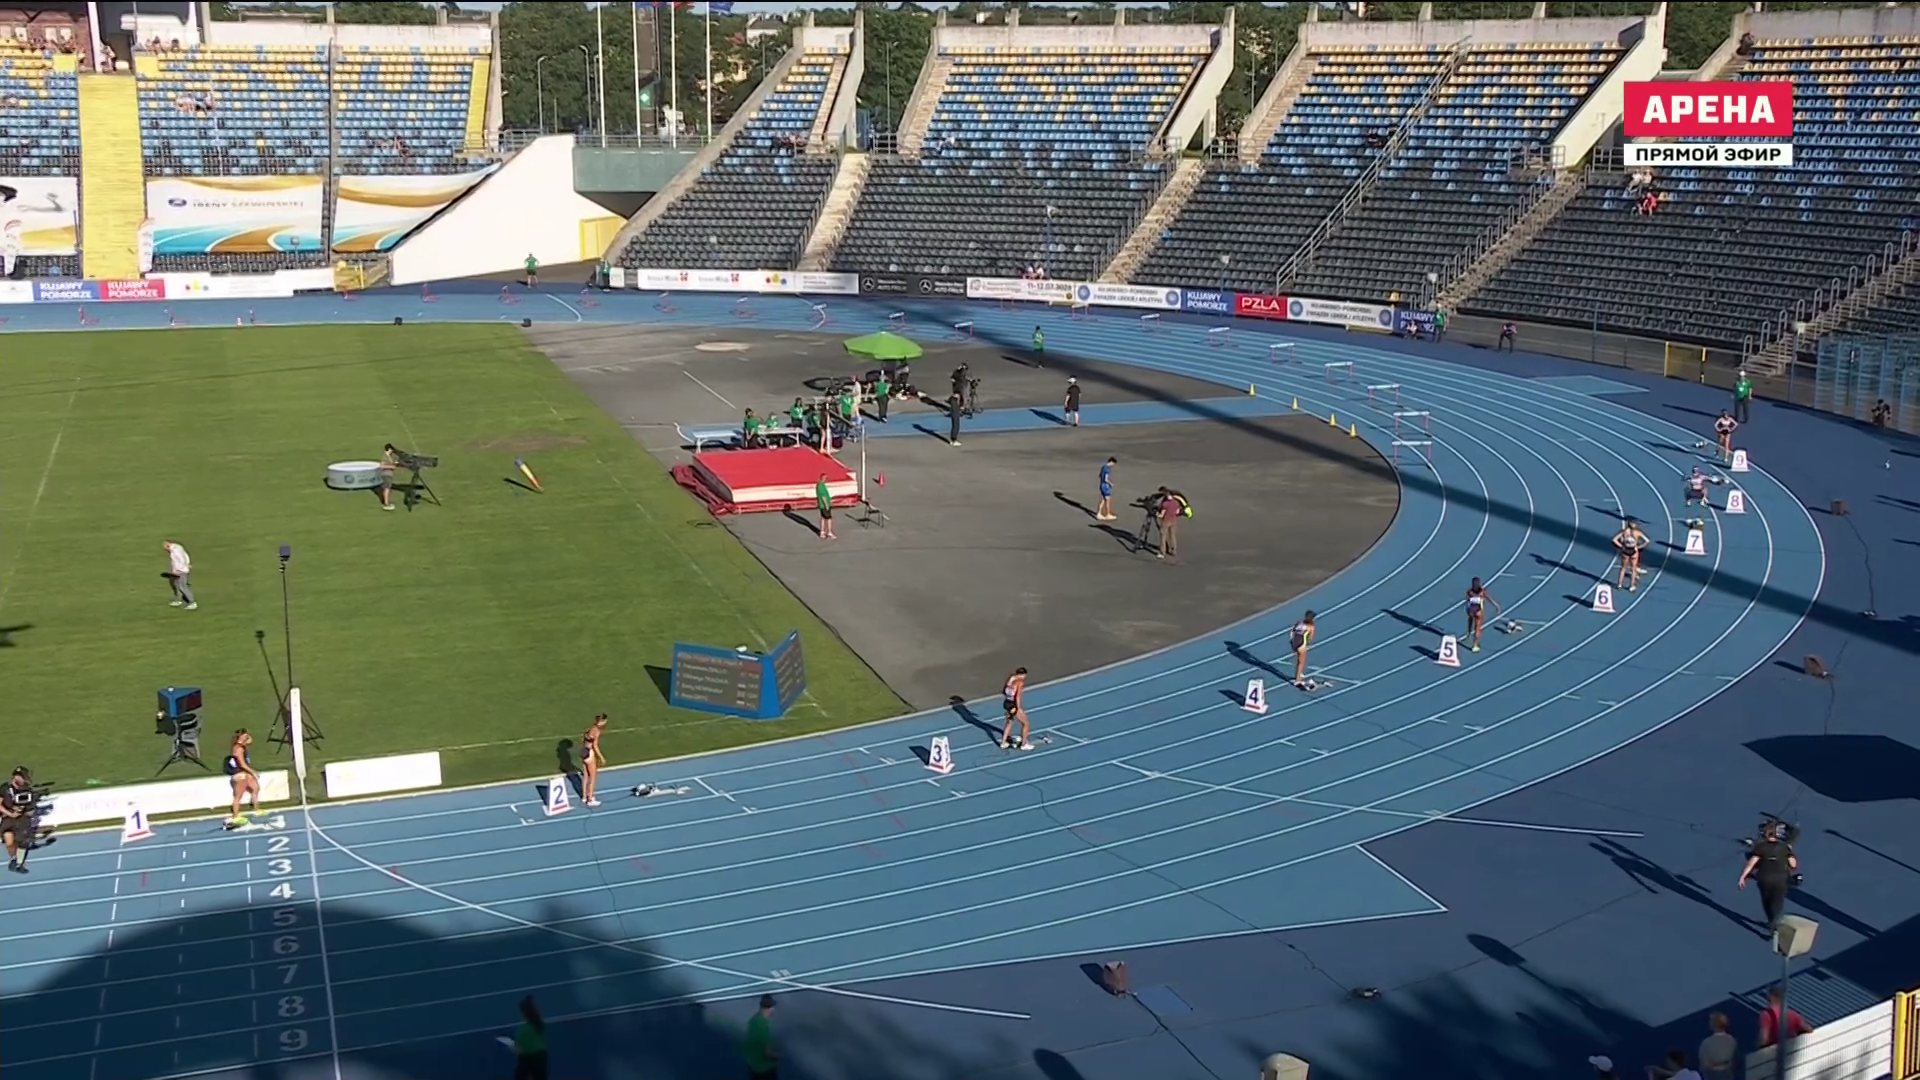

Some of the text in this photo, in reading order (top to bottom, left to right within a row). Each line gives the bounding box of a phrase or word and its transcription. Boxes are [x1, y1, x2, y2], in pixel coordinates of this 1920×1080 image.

[40, 281, 83, 290] KUJAWY
[108, 281, 149, 290] KUJAWY
[108, 289, 158, 298] POMORZE
[40, 290, 92, 299] POMORZE
[1187, 290, 1222, 302] KUJAWY
[1187, 300, 1228, 312] POMORZE
[1241, 296, 1279, 310] PZLA
[1400, 310, 1435, 323] KUJAWY
[1735, 454, 1744, 467] 9
[1730, 495, 1740, 508] 8
[1690, 535, 1701, 548] 7
[1598, 590, 1609, 605] 6
[1443, 641, 1454, 658] 5
[1248, 687, 1259, 704] 4
[932, 744, 943, 763] 3
[552, 784, 565, 805] 2
[131, 810, 143, 830] 1
[267, 836, 290, 852] 2
[268, 859, 293, 876] 3
[269, 882, 295, 899] 4
[273, 907, 297, 927] 5
[273, 934, 299, 954] 6
[277, 964, 298, 985] 7
[277, 996, 304, 1017] 8
[279, 1028, 309, 1051] 9
